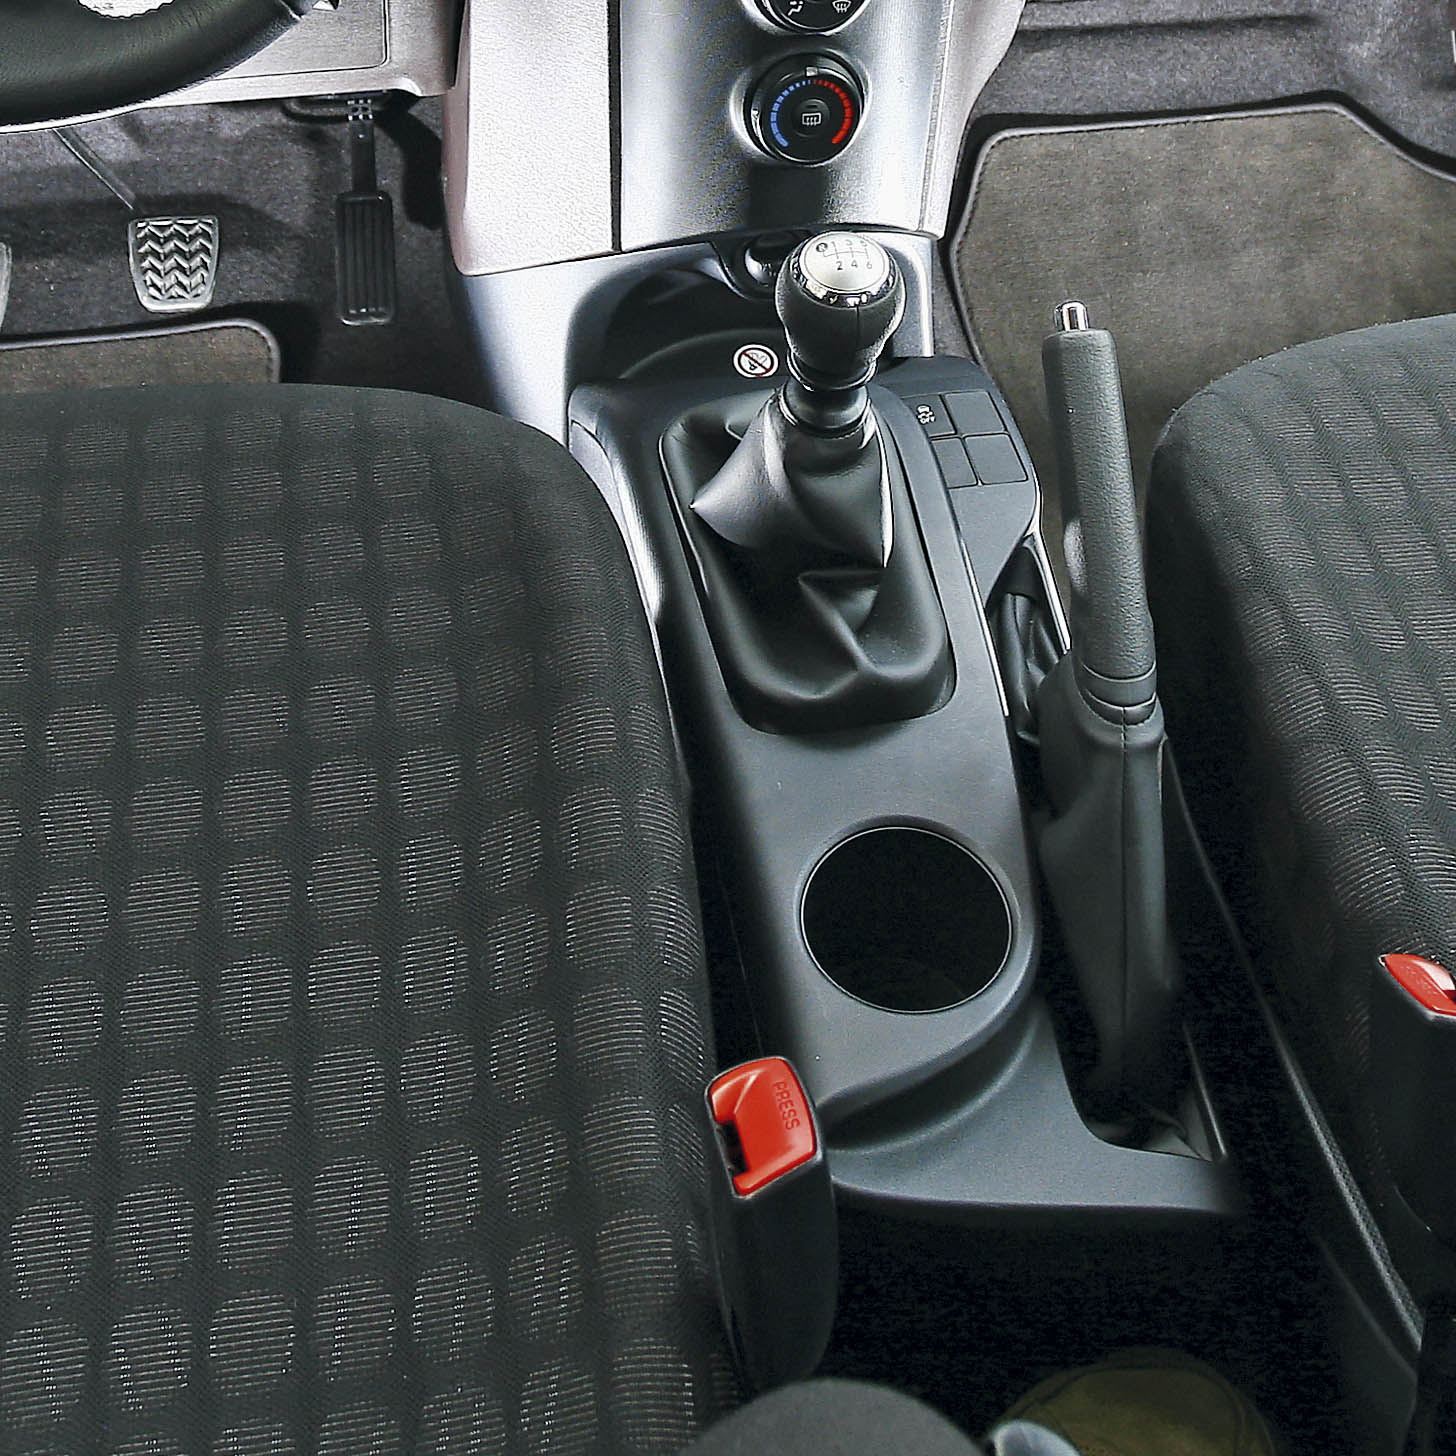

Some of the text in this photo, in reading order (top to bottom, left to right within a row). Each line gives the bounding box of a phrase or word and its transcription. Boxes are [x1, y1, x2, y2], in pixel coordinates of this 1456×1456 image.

[836, 260, 843, 270] 2
[851, 259, 858, 268] 4
[866, 261, 873, 270] 6
[775, 1081, 800, 1131] PRESS
